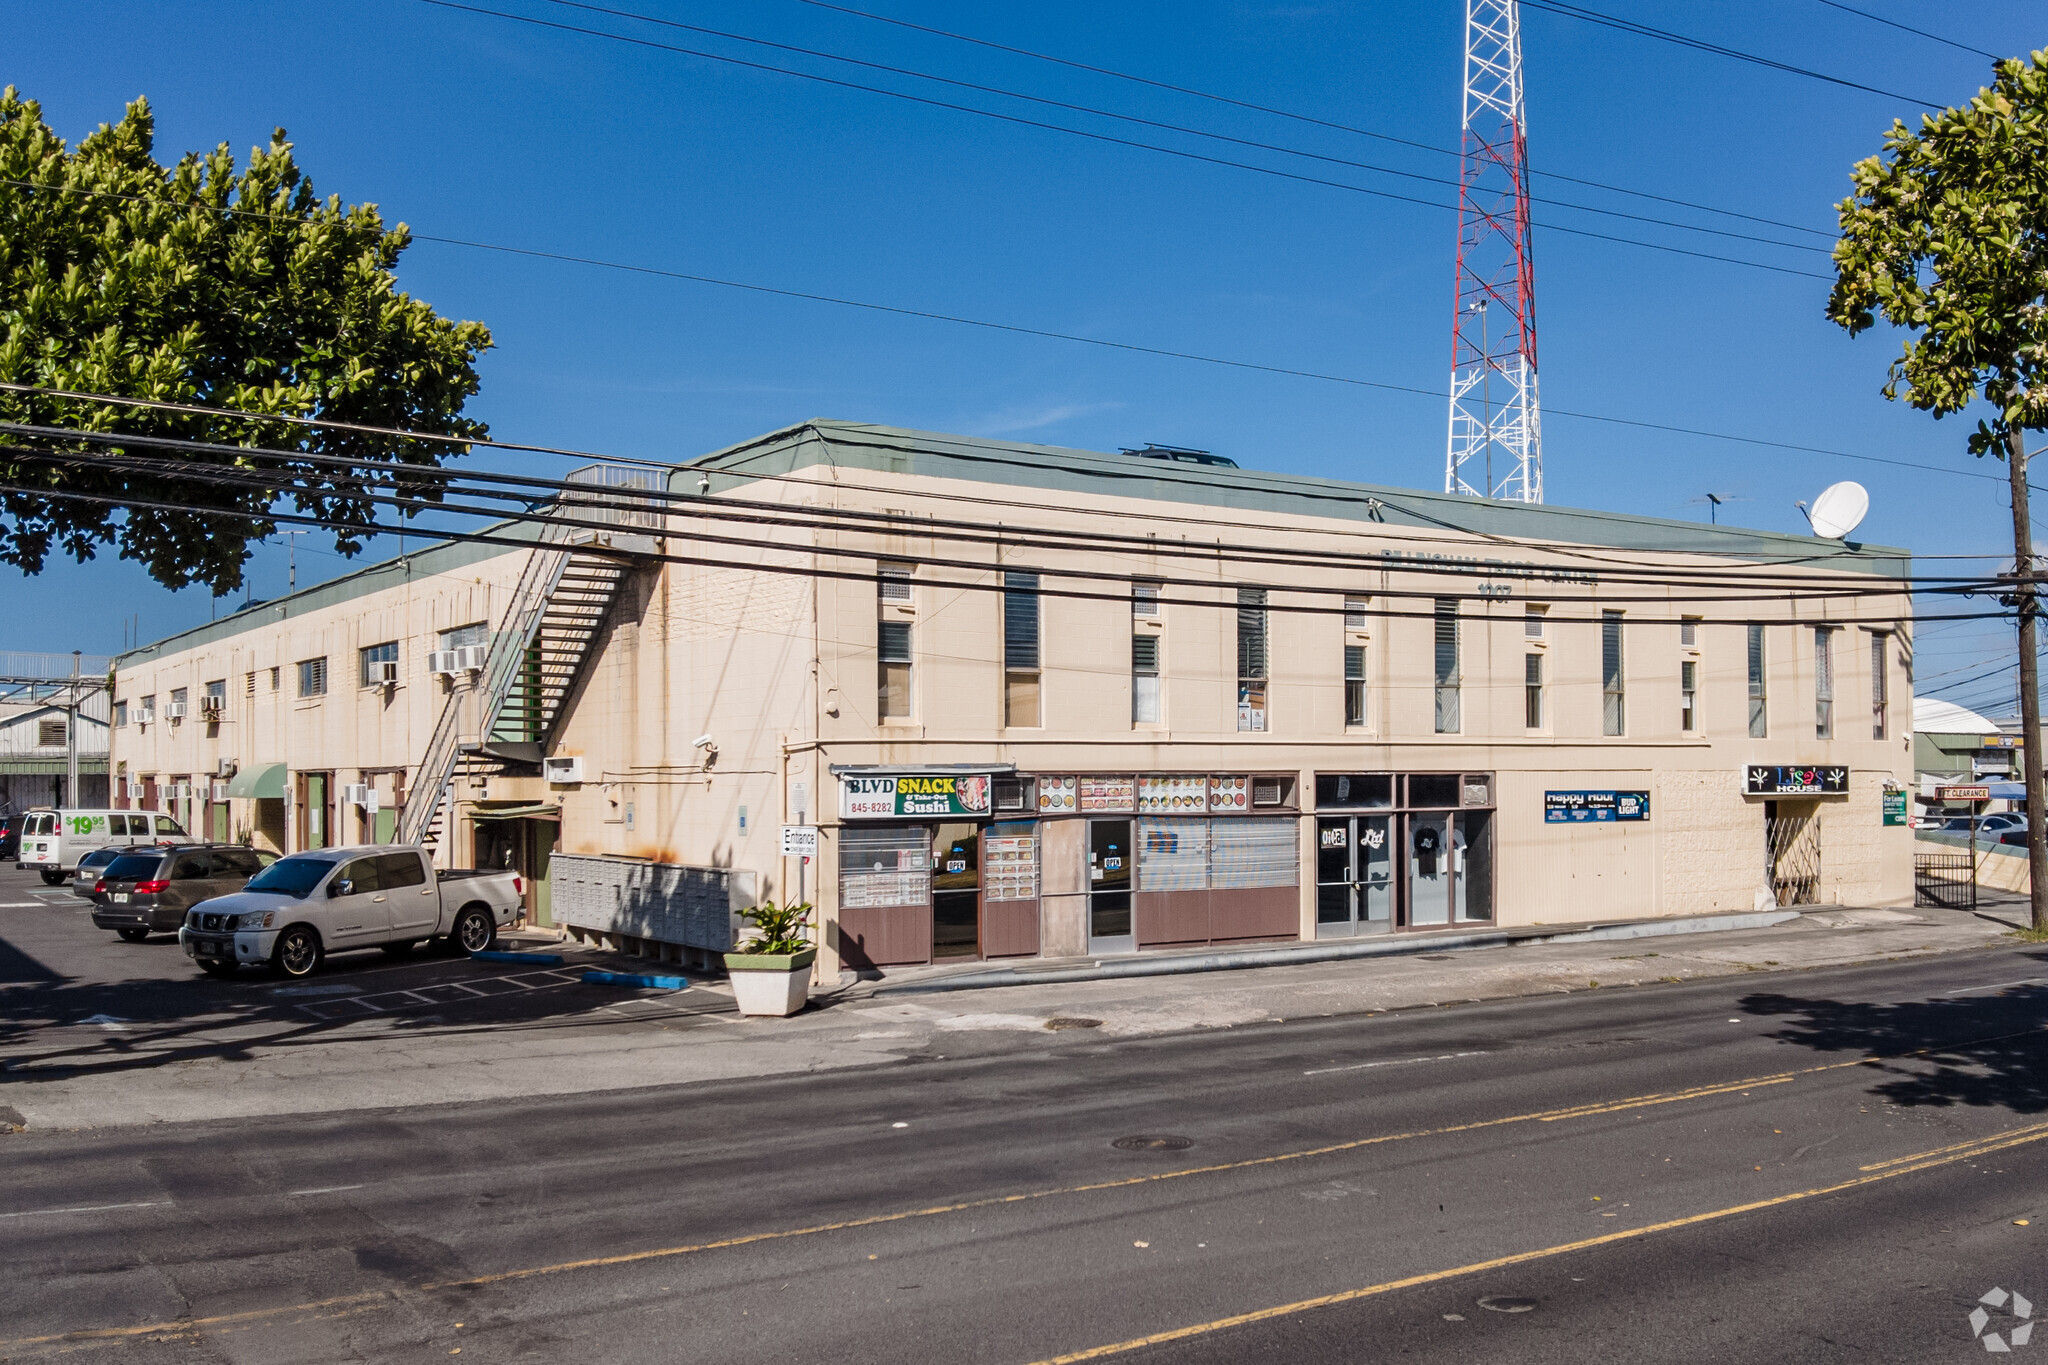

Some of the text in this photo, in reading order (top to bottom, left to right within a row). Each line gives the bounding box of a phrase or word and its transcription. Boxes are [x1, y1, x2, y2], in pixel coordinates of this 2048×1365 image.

[1775, 767, 1824, 786] Lisa's
[850, 778, 956, 794] BLVD SNACK
[1952, 789, 1987, 798] CLEARANCE
[1546, 794, 1584, 804] Happy
[1621, 798, 1636, 806] BUD
[851, 803, 892, 813] 845-8282
[903, 801, 950, 813] Sushi
[1618, 806, 1640, 814] LIGHT
[948, 861, 965, 870] OPEN
[1105, 858, 1120, 867] OPEN
